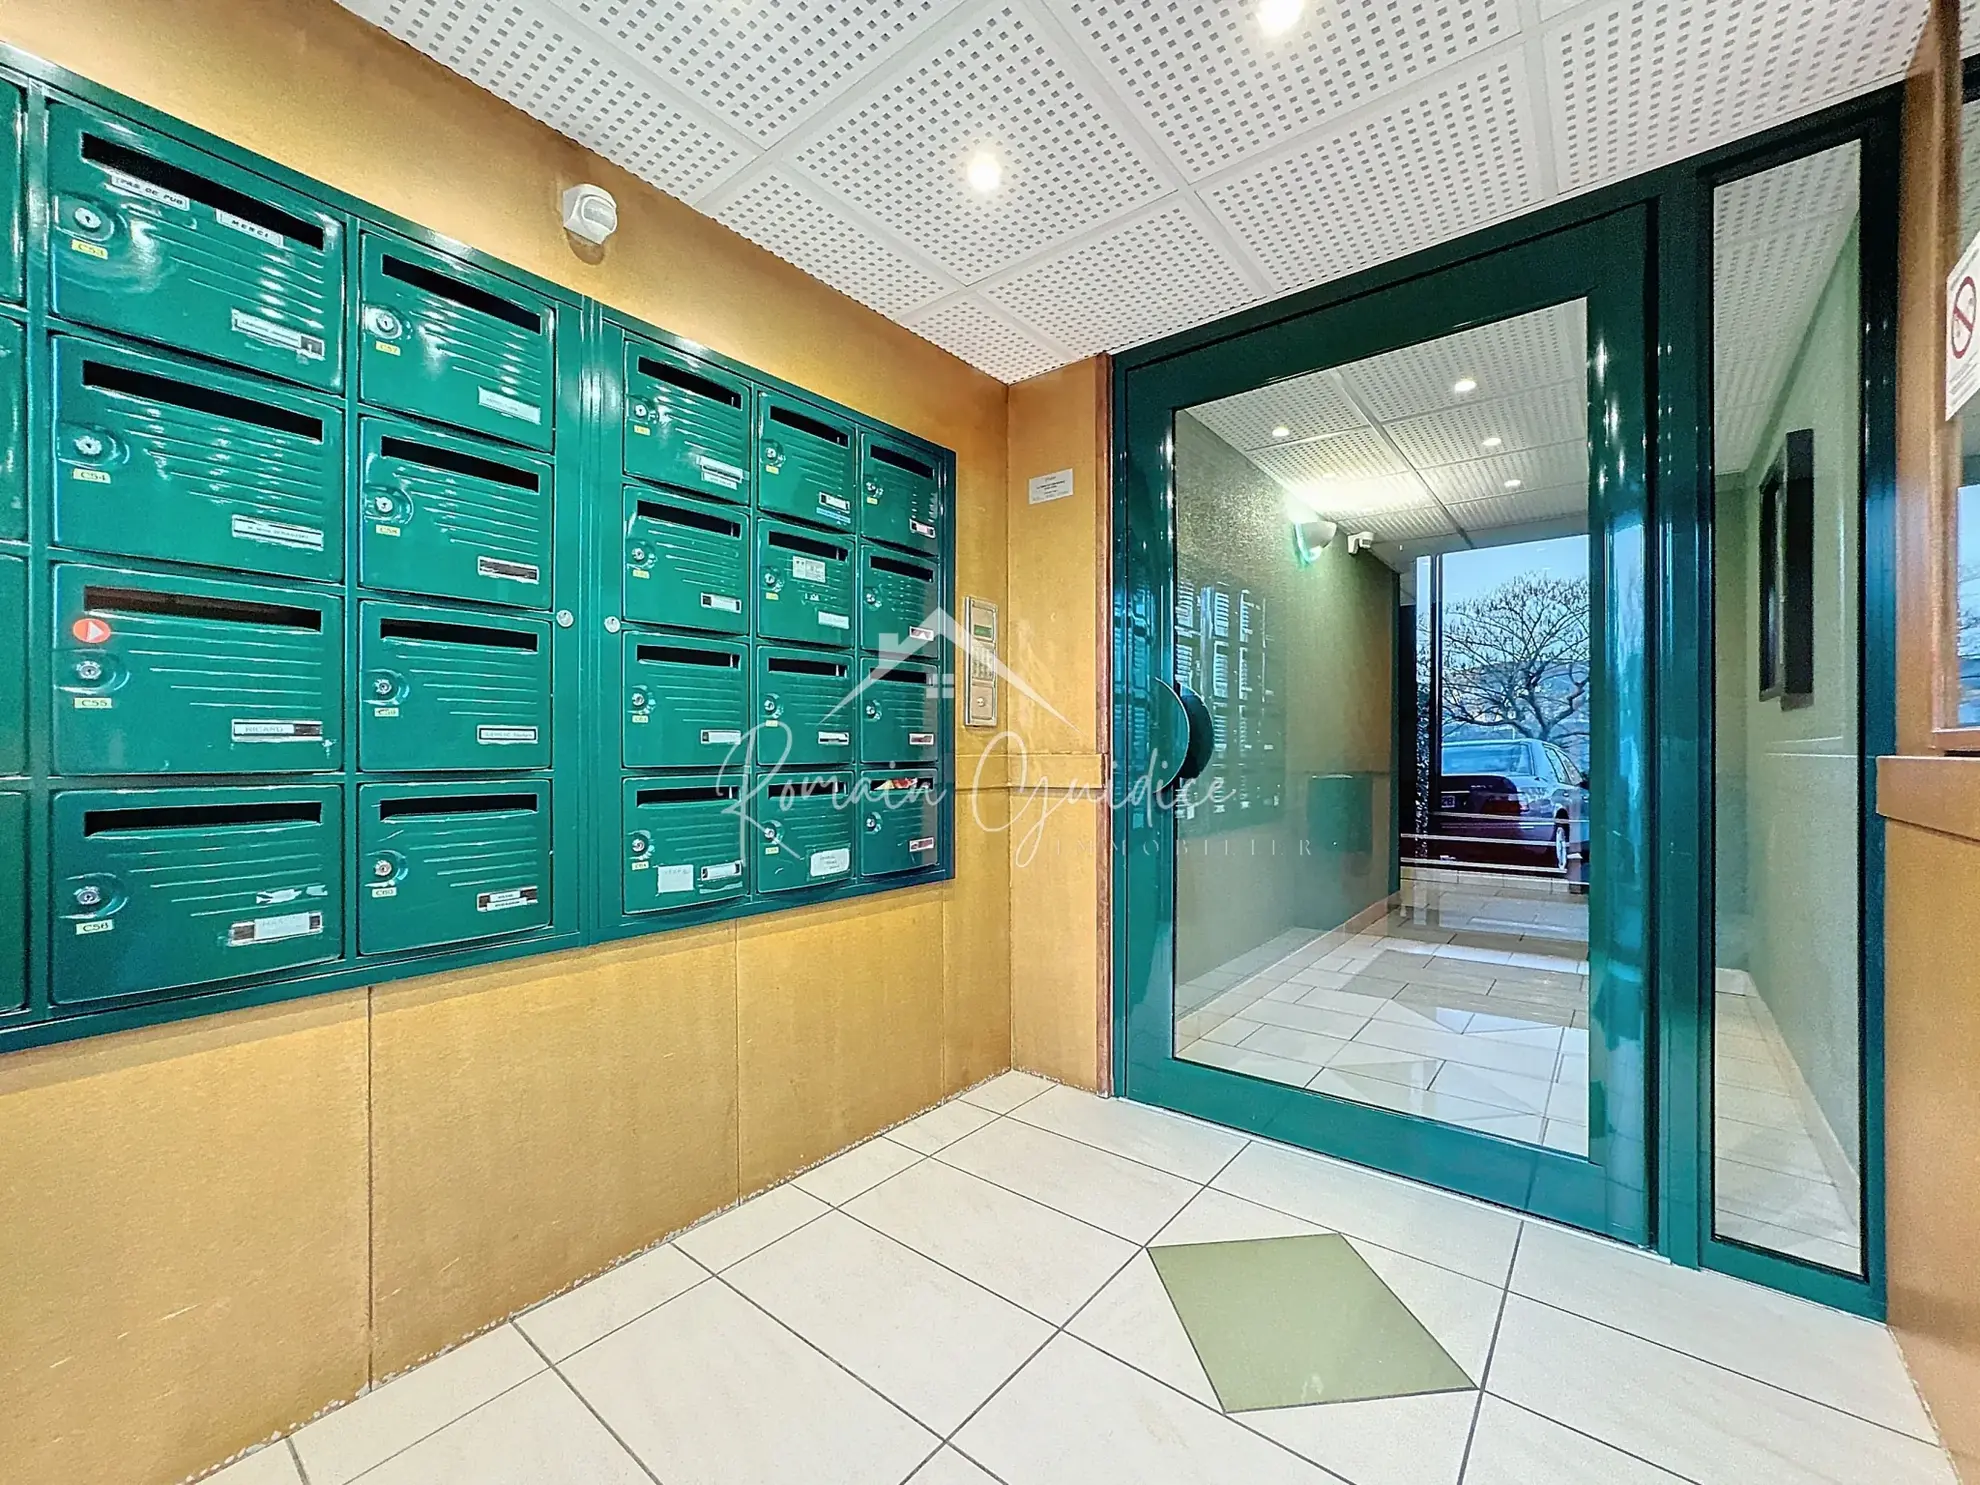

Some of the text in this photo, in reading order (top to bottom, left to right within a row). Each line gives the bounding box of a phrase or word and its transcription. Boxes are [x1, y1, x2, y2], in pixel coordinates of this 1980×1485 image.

[119, 177, 184, 206] PAS DE PUB
[231, 219, 270, 239] MERCI
